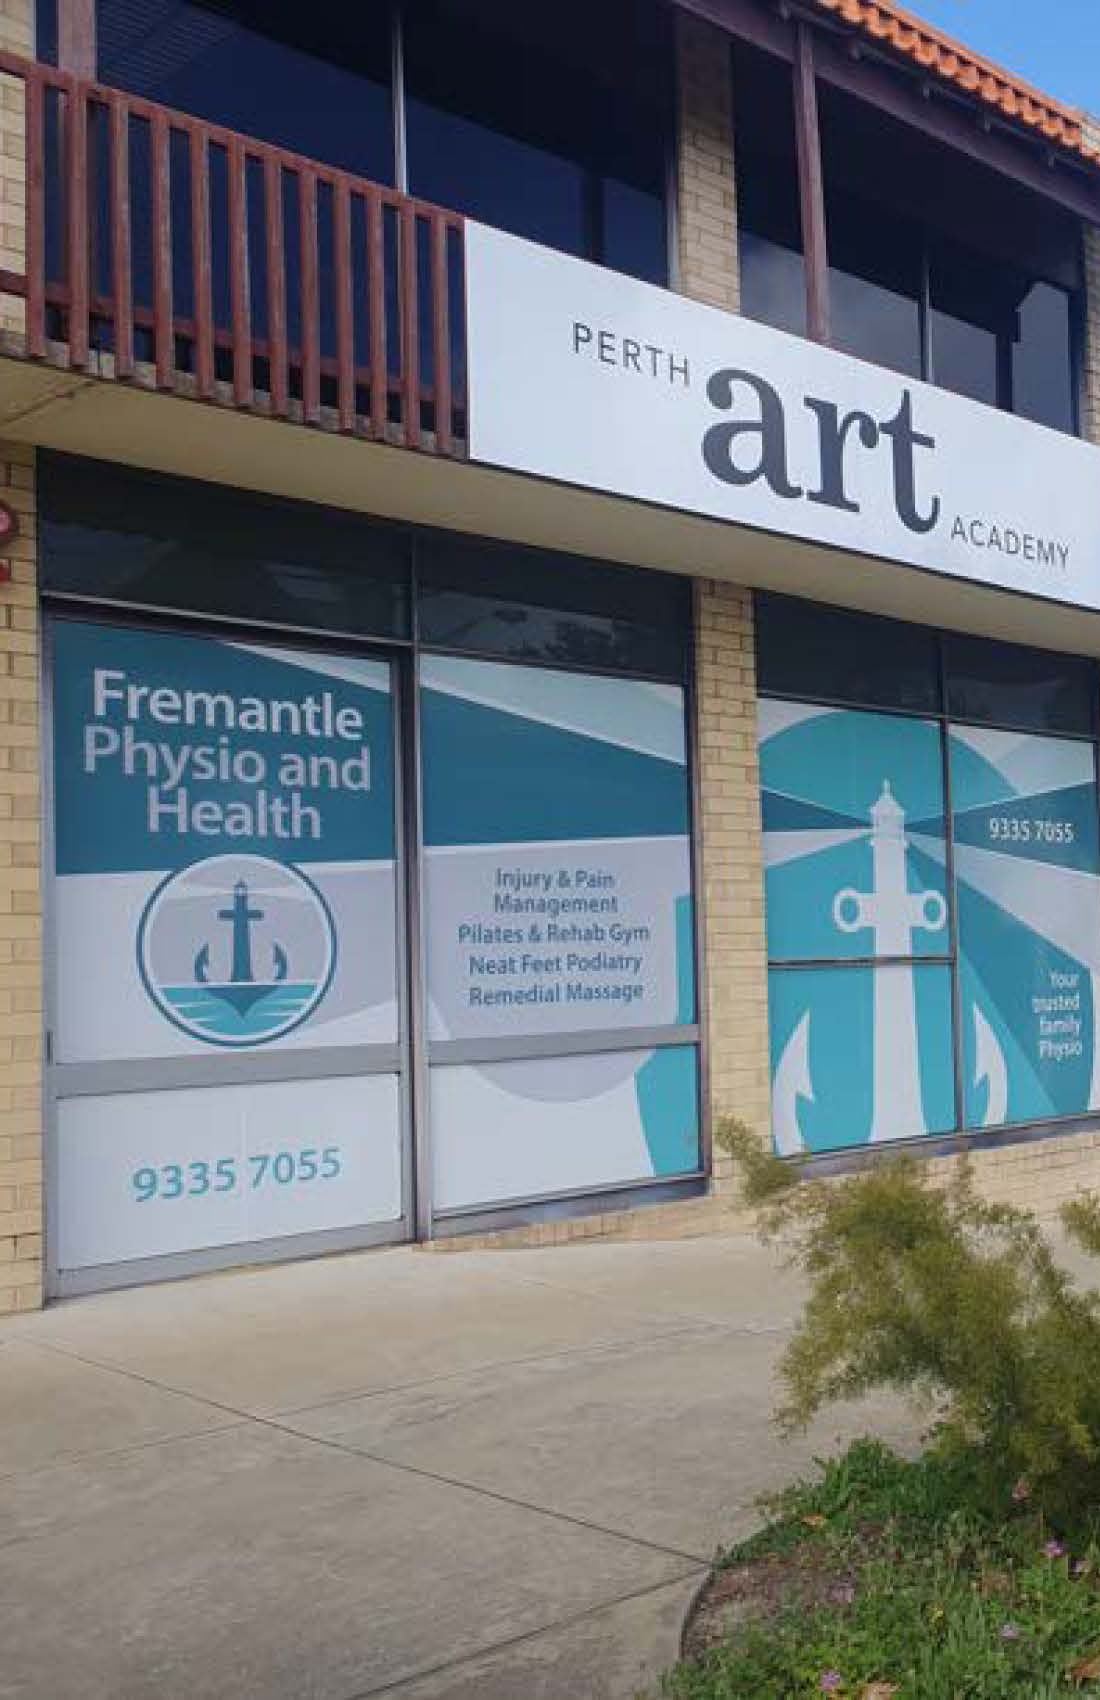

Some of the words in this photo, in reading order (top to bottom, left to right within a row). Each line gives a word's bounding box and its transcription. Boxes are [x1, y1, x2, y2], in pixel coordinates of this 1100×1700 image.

[573, 321, 690, 387] PERTH
[702, 367, 940, 533] art
[950, 515, 1070, 568] ACADEMY
[94, 668, 363, 740] Fremantle
[83, 724, 267, 791] Physio
[278, 746, 371, 792] and
[147, 786, 321, 839] Health
[989, 817, 1030, 842] 9335
[1034, 819, 1075, 844] 7055
[497, 868, 552, 892] Injury
[558, 870, 571, 888] &
[575, 869, 616, 889] Pain
[495, 893, 618, 918] Management
[458, 922, 523, 944] Pilates
[528, 922, 543, 943] &
[547, 923, 605, 943] Rehab
[608, 923, 649, 946] Gym
[469, 956, 517, 976] Neat
[522, 954, 561, 974] Feet
[566, 951, 643, 976] Podiatry
[1049, 972, 1080, 989] Your
[469, 983, 560, 1006] Remedial
[566, 982, 644, 1004] Massage
[1032, 992, 1080, 1013] trusted
[1040, 1014, 1081, 1036] family
[1039, 1039, 1082, 1062] Physio
[132, 1158, 236, 1202] 9335
[248, 1146, 341, 1189] 7055
